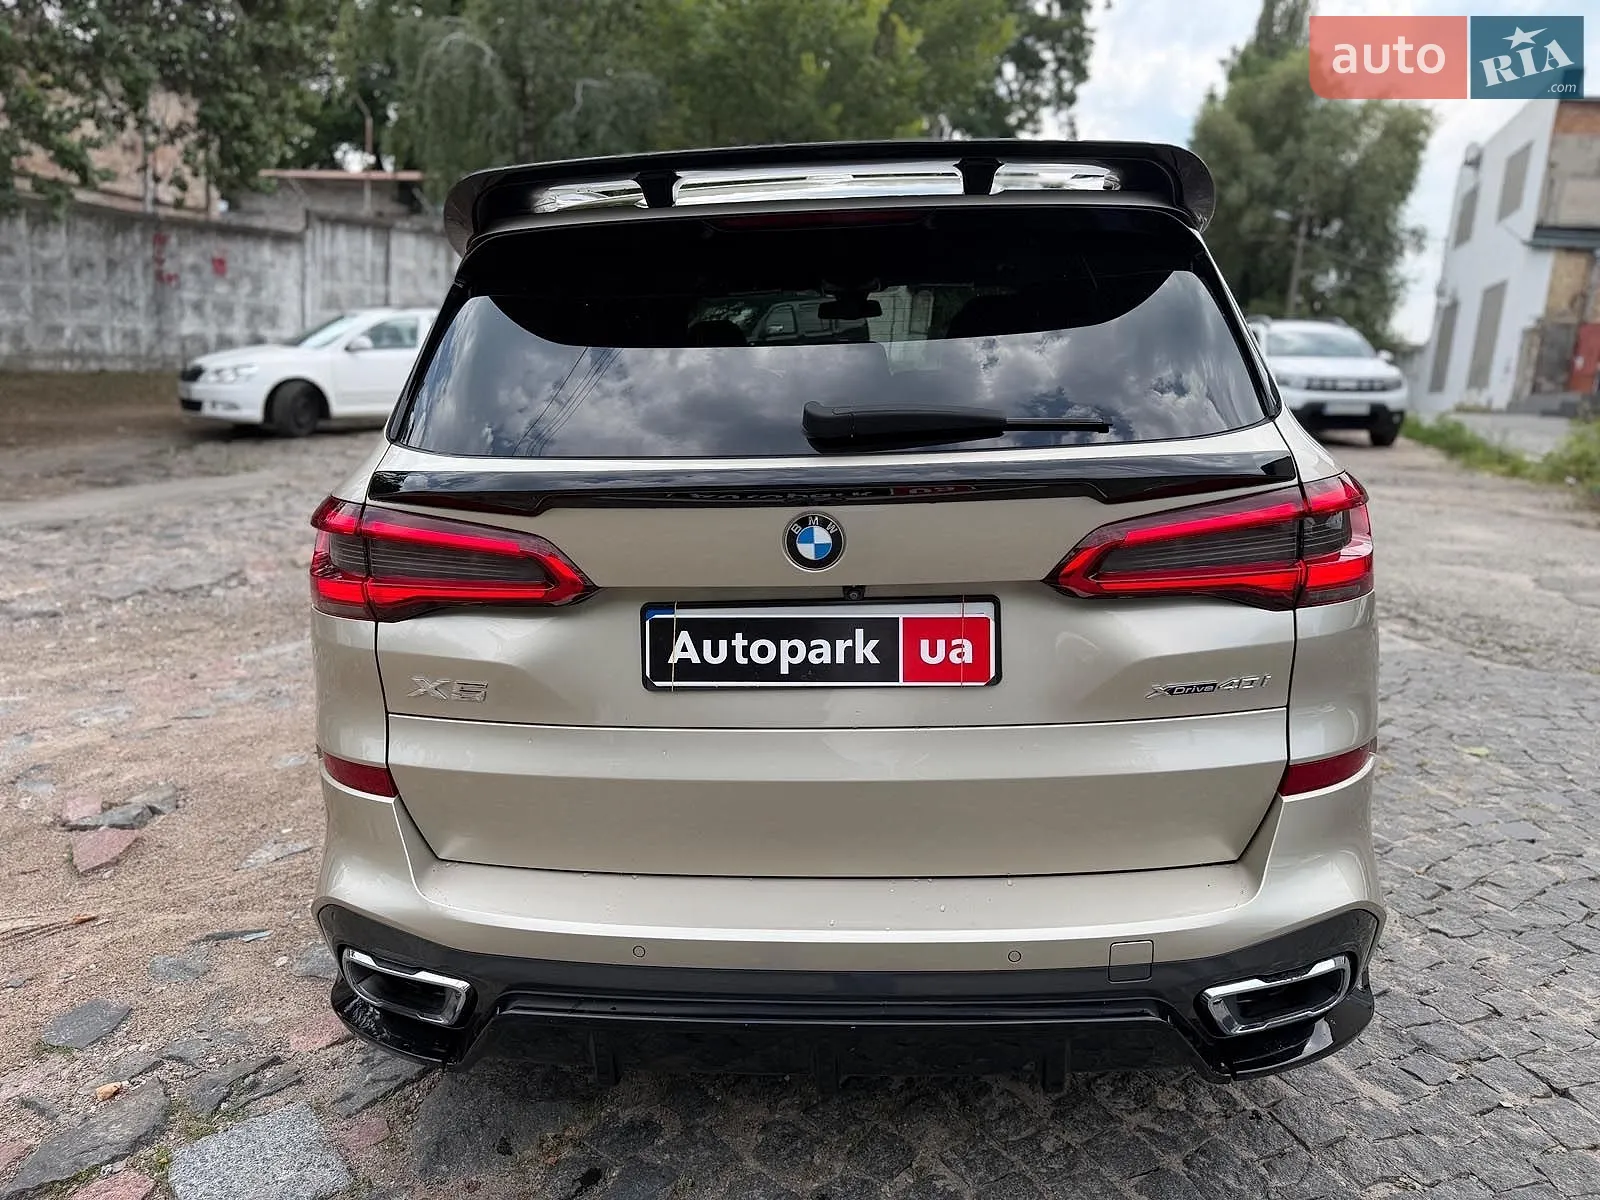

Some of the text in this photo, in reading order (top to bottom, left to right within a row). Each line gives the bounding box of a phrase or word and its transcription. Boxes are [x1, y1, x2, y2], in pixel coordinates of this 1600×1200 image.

[790, 516, 838, 535] BMW
[667, 628, 974, 675] Autopark ua
[407, 677, 488, 702] X5
